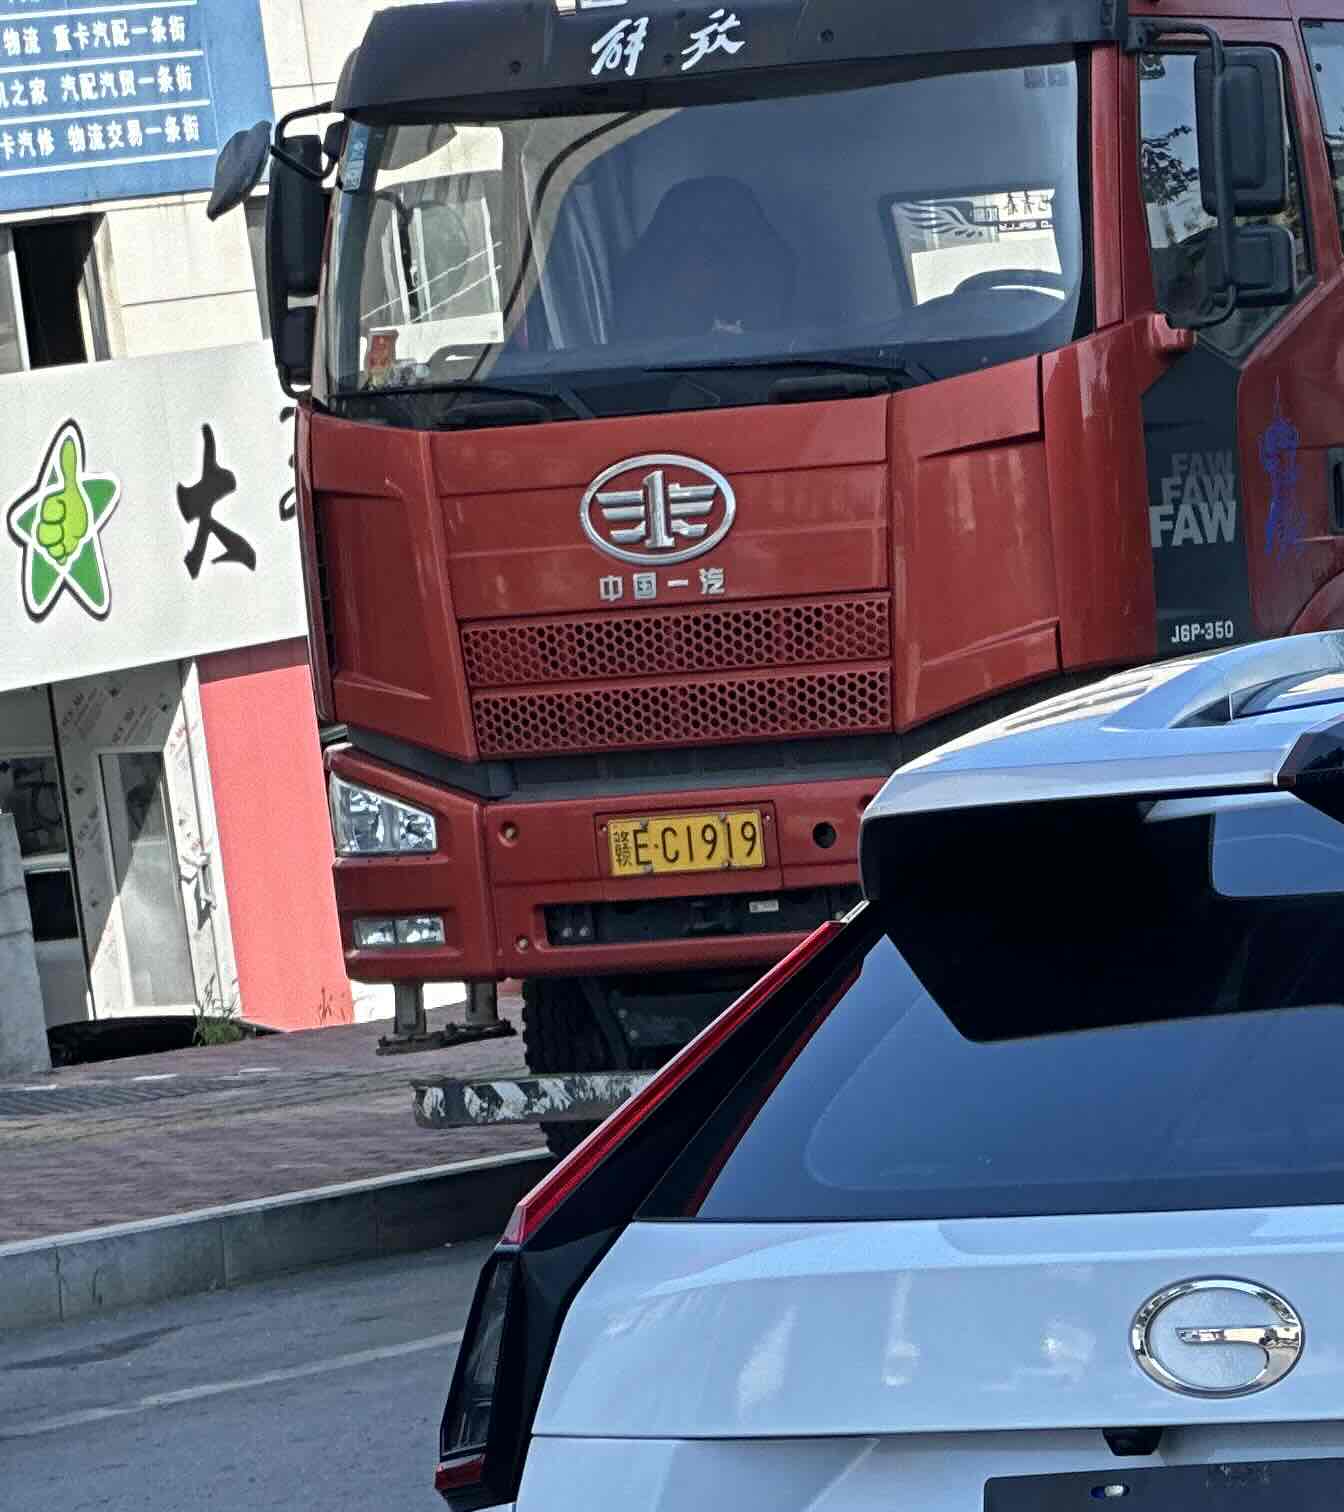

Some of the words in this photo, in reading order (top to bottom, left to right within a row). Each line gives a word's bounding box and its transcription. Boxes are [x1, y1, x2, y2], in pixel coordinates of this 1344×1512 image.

[591, 8, 746, 76] 解放
[1149, 500, 1237, 548] FAW
[599, 567, 726, 602] 中国一汽
